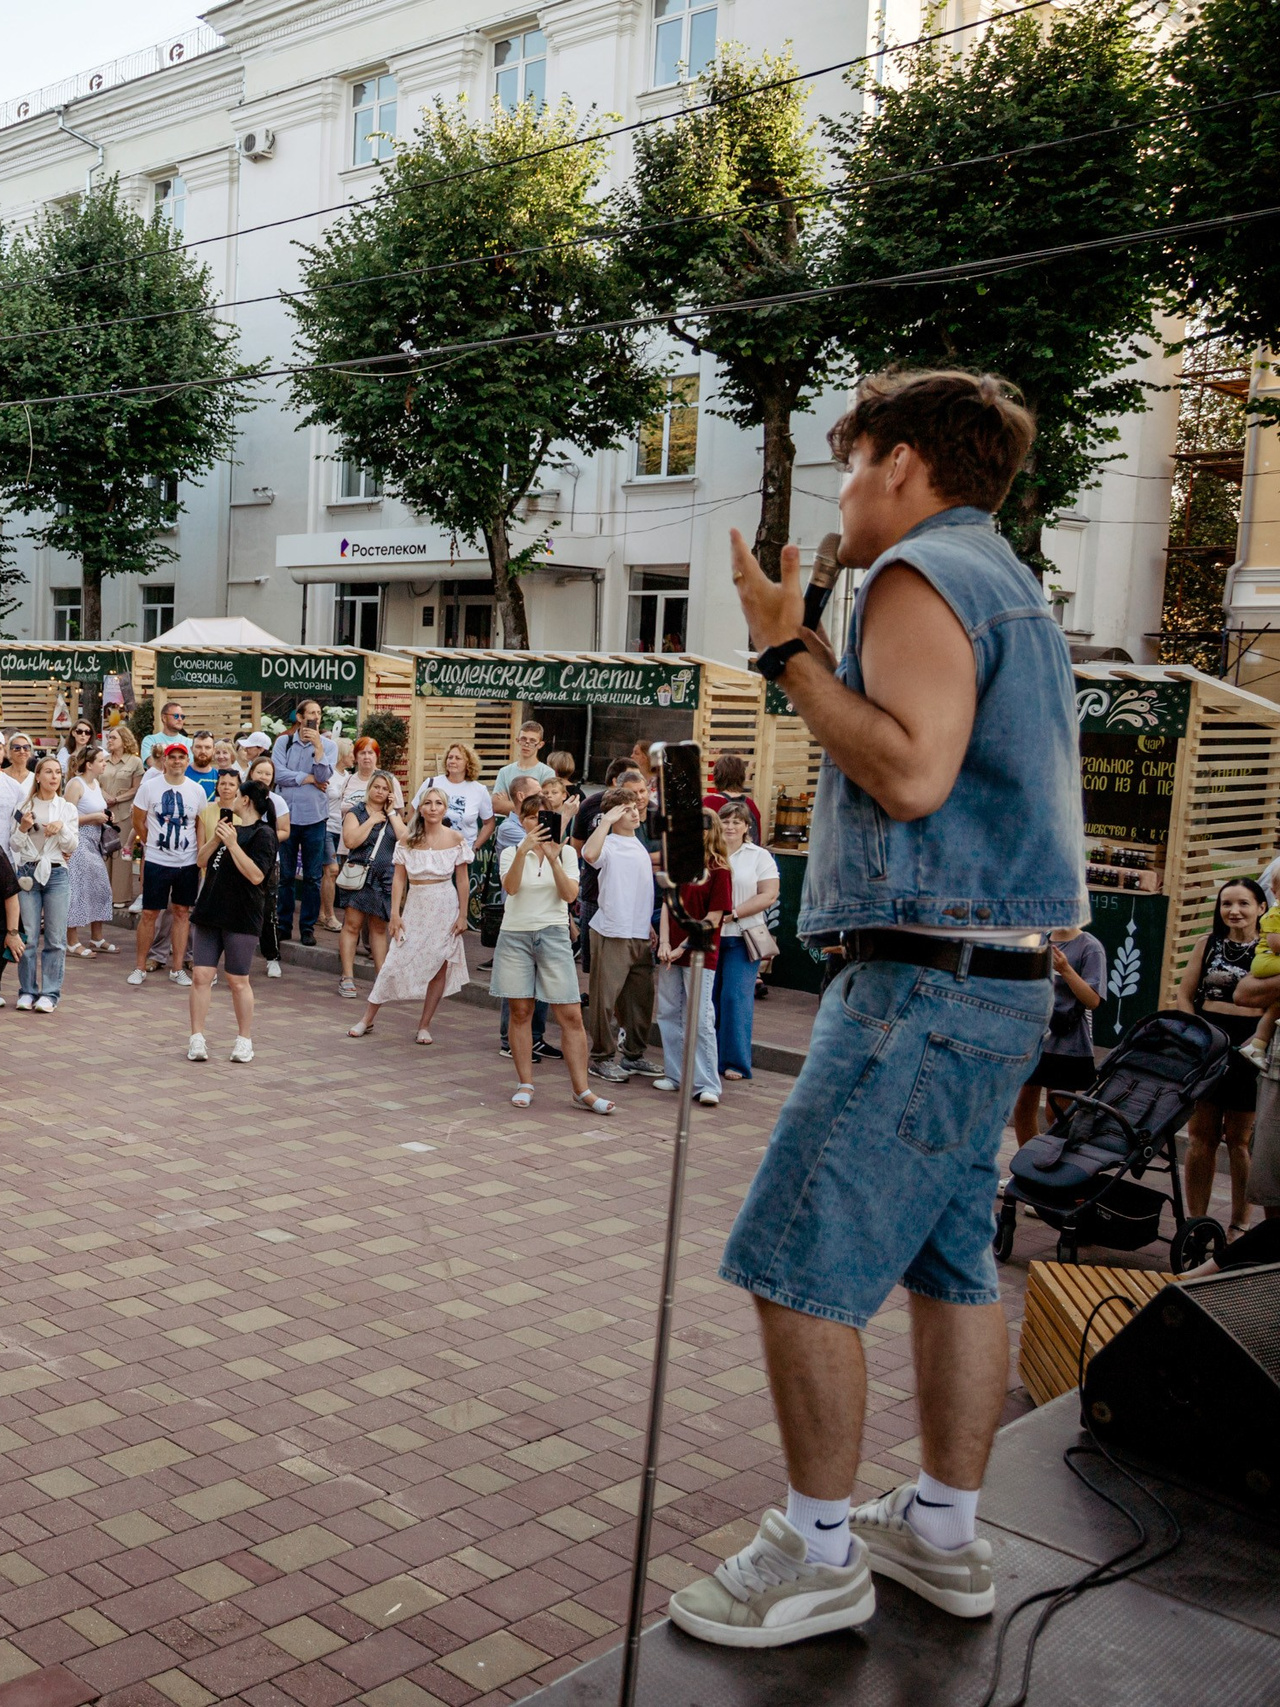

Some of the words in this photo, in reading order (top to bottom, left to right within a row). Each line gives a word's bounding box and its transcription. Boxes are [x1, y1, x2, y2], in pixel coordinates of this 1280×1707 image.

[351, 542, 427, 557] Ростелеком
[173, 655, 233, 672] Смоленские
[185, 671, 223, 684] сезоны
[424, 659, 546, 687] Смоленские
[283, 680, 332, 691] рестораны
[572, 692, 581, 701] и
